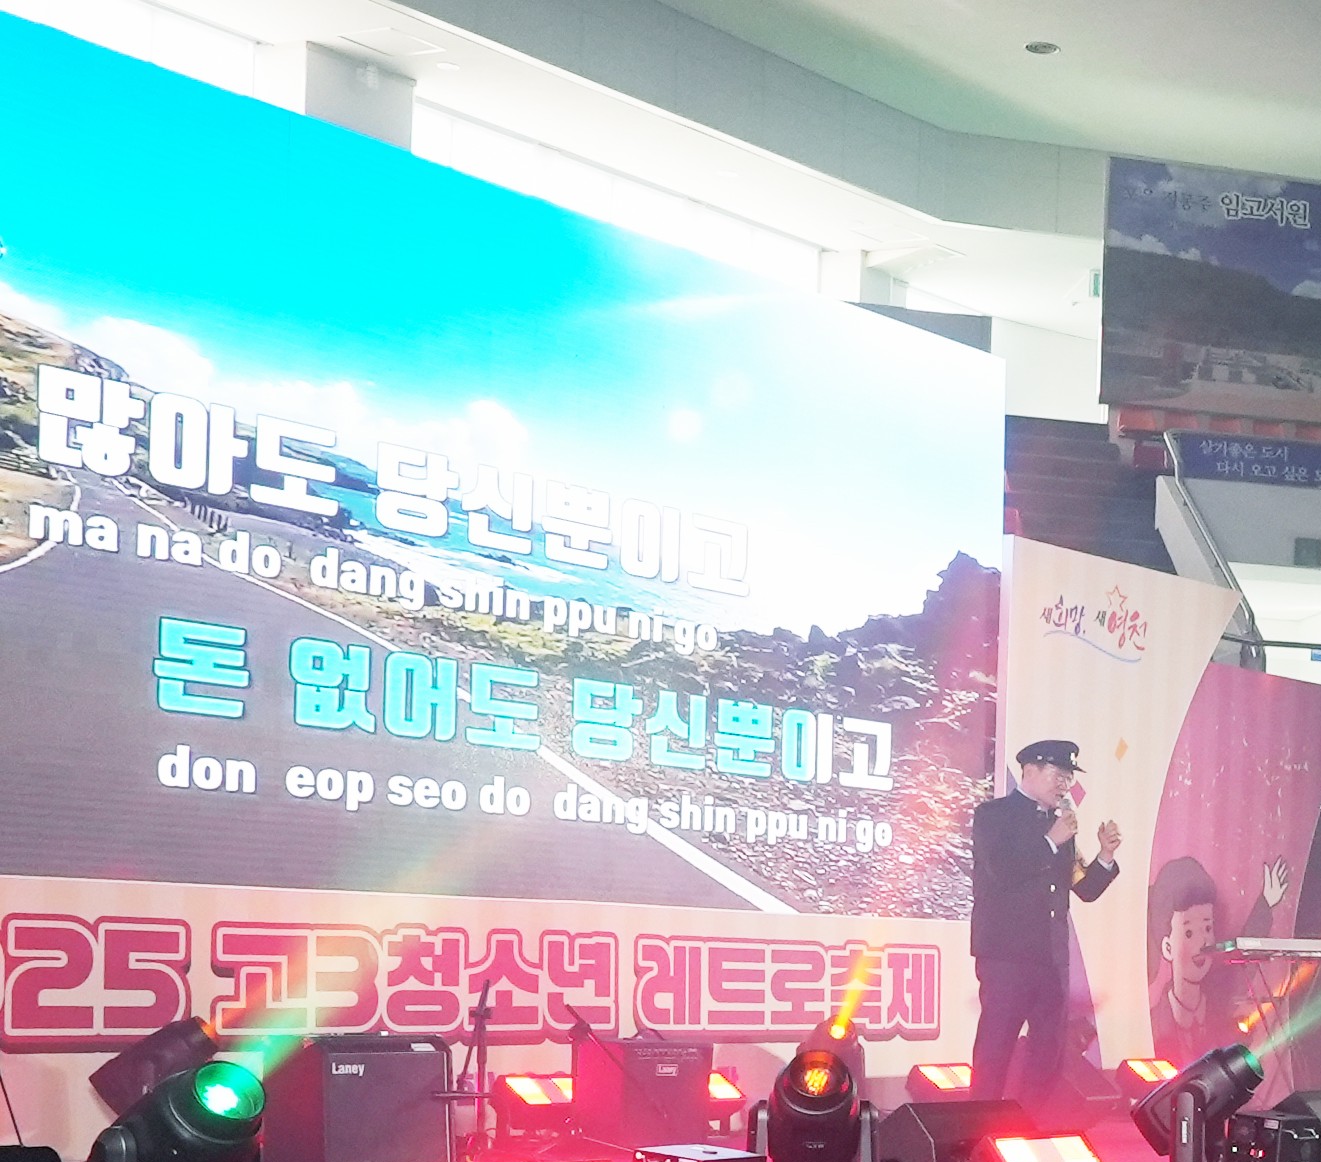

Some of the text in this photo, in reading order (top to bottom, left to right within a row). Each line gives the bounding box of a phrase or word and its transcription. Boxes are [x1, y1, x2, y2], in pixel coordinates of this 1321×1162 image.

[1219, 191, 1311, 229] 임고서원
[37, 363, 750, 597] 많아도 당신뿐이고
[1216, 459, 1244, 478] 다시
[1251, 463, 1278, 479] 오고
[1282, 465, 1310, 482] 싶은
[1261, 445, 1290, 462] 도시
[28, 502, 719, 655] ma na do dang shin ppu ni go
[152, 615, 895, 792] 돈 없어도 당신뿐이고
[157, 744, 894, 852] don eop seo do dang shin ppu ni go
[212, 921, 619, 1042] 고3청소년
[635, 934, 940, 1038] 레트로축제
[331, 1061, 366, 1077] Laney
